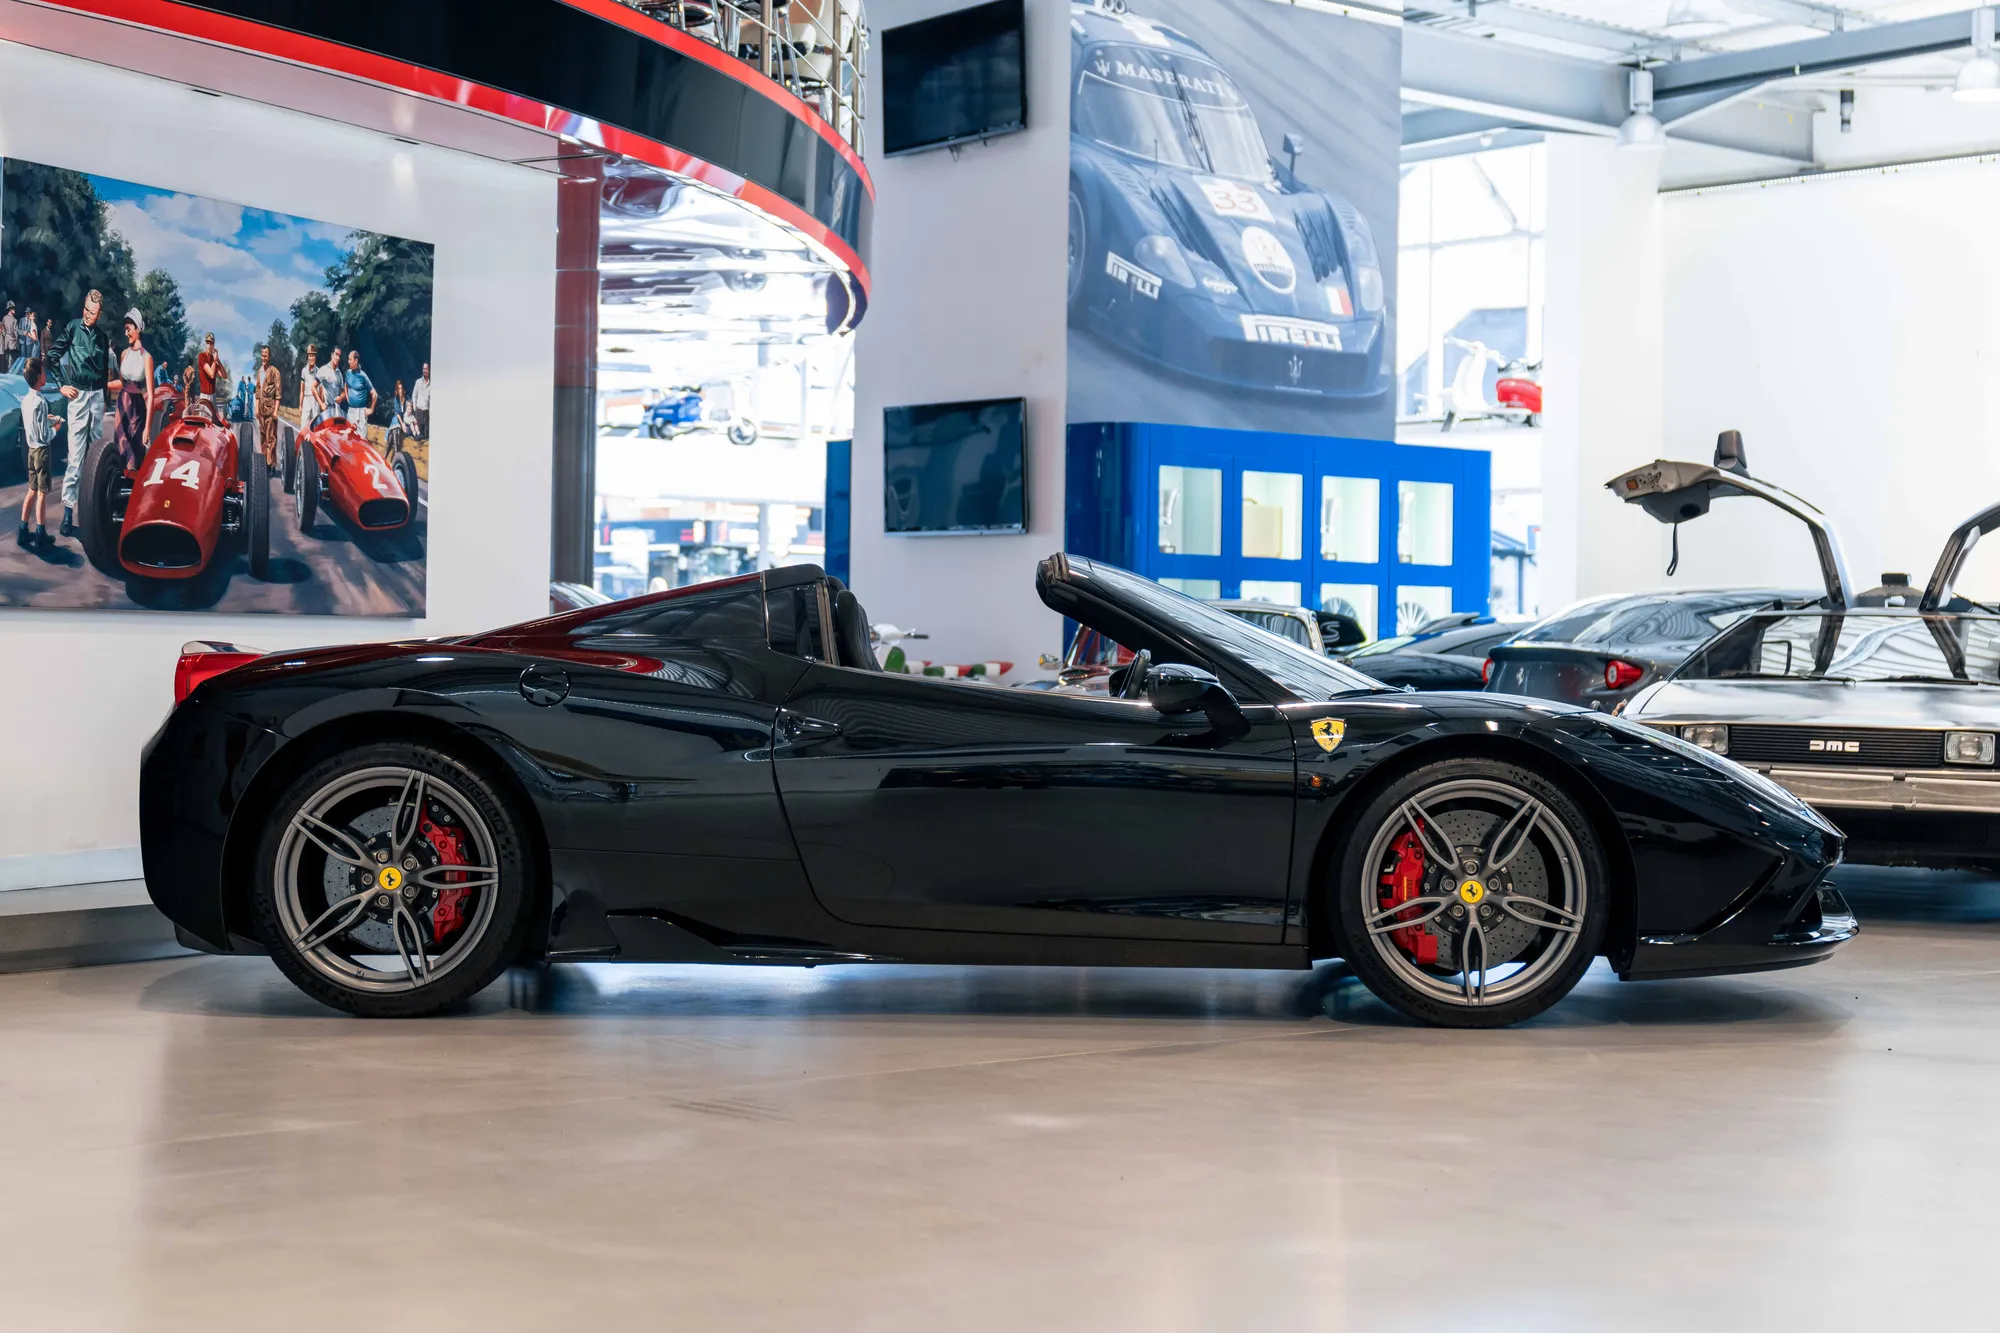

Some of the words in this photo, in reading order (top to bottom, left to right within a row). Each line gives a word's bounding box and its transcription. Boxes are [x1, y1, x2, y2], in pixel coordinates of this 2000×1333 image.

[1115, 60, 1225, 97] MASERATI
[1213, 190, 1259, 214] 33
[1240, 314, 1343, 351] PIRELLI
[143, 457, 200, 490] 14
[364, 464, 388, 489] 2
